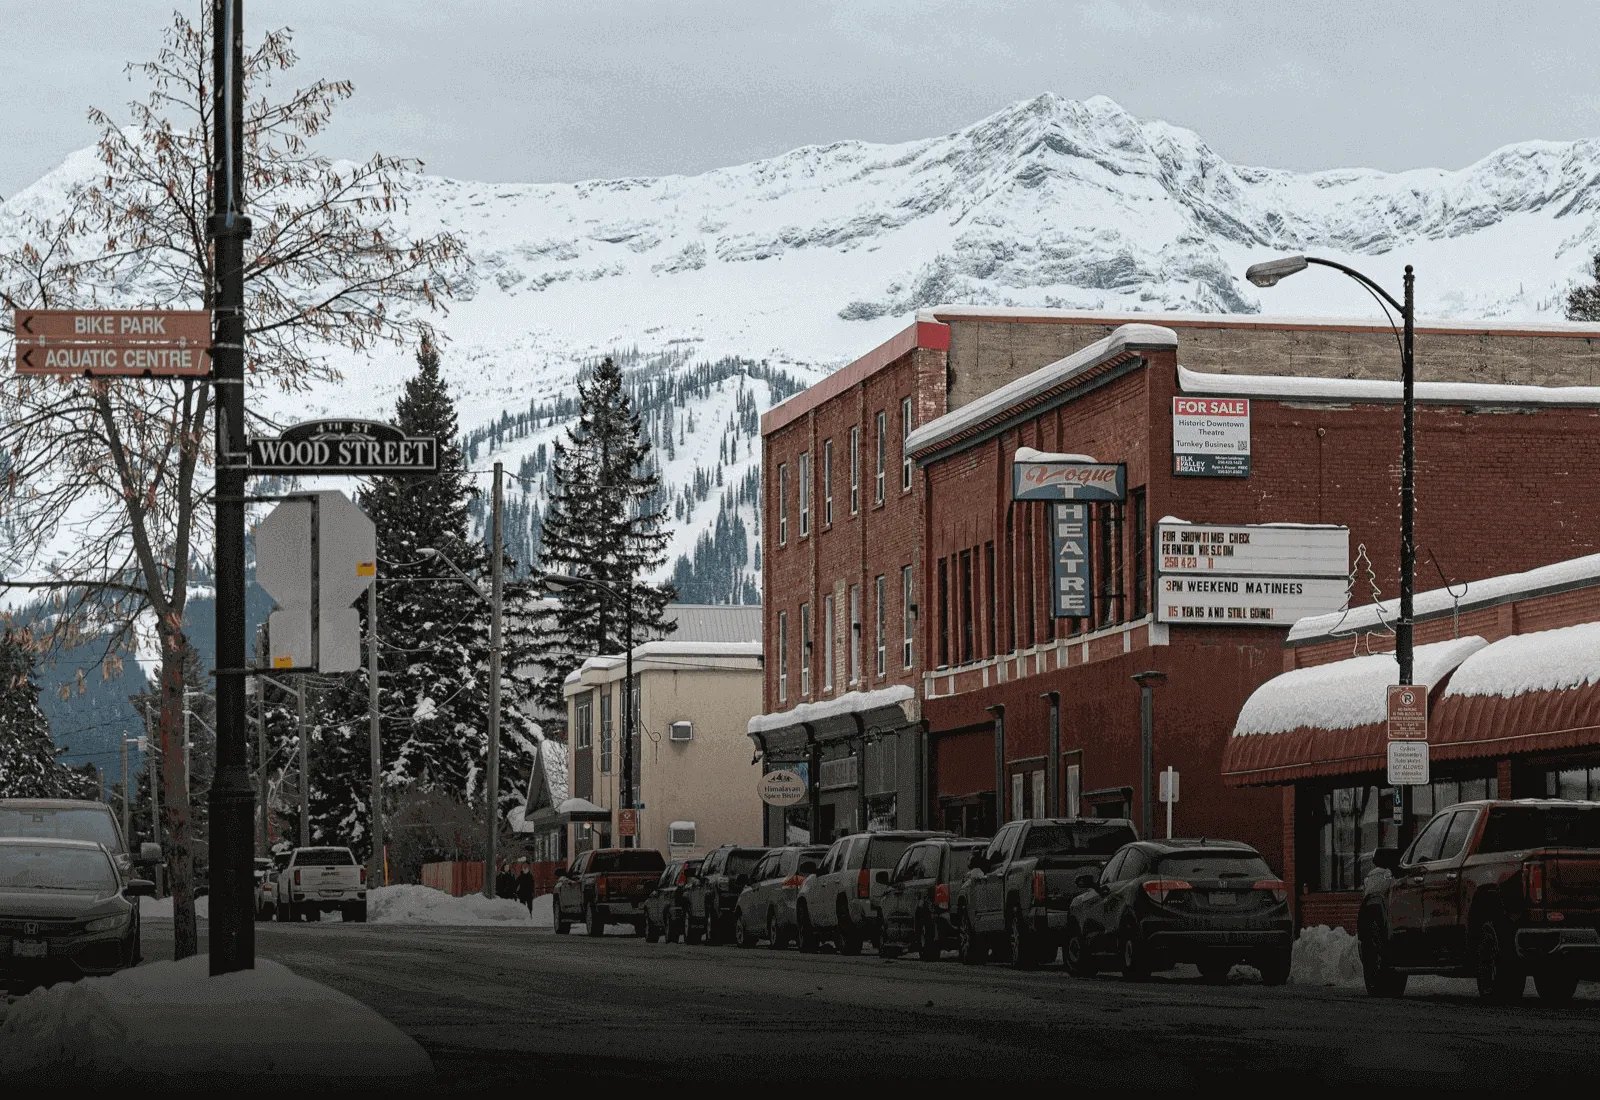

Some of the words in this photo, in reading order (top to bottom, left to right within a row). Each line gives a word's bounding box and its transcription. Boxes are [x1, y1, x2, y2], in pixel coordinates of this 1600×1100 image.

[74, 316, 114, 334] BIKE
[120, 316, 166, 334] PARK
[45, 349, 117, 368] AQUATIC
[123, 349, 192, 368] CENTRE
[1178, 401, 1207, 413] FOR
[1210, 402, 1244, 414] SALE
[316, 422, 342, 433] 4TH
[352, 423, 371, 433] ST
[1178, 419, 1205, 427] Historic
[1206, 420, 1245, 428] Downtown
[1198, 428, 1225, 436] Theatre
[1176, 440, 1203, 449] Turnkey
[1205, 441, 1235, 449] Business
[257, 441, 330, 465] WOOD
[338, 441, 429, 465] STREET
[1162, 531, 1176, 542] FOR
[1181, 531, 1225, 544] SHOWTIMES
[1229, 532, 1250, 544] CHECK
[1057, 484, 1085, 609] THEATRE
[1164, 556, 1179, 568] 250
[1181, 556, 1197, 568] 423
[1166, 580, 1183, 592] 3PM
[1187, 581, 1239, 593] WEEKEND
[1245, 582, 1303, 594] MATINEES
[1182, 606, 1204, 618] YEARS
[1208, 607, 1224, 618] AND
[1227, 607, 1247, 619] STILL
[764, 785, 801, 793] Himalayan
